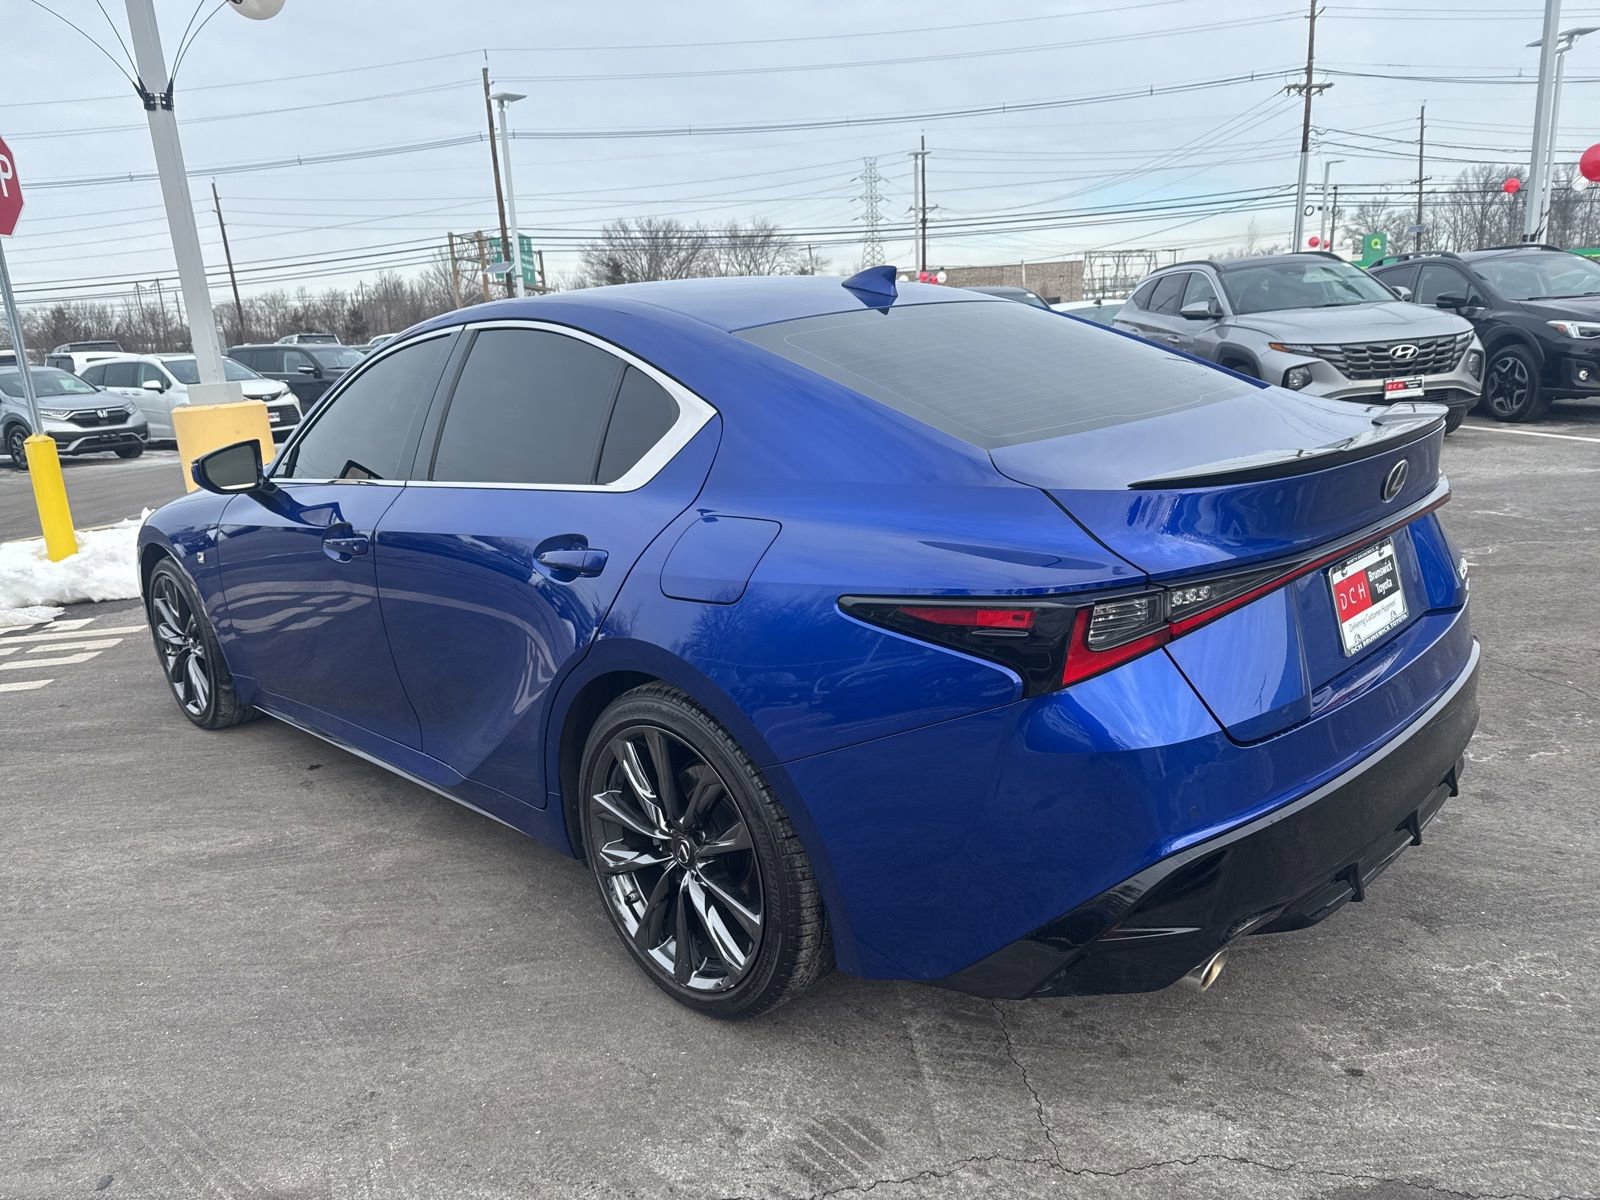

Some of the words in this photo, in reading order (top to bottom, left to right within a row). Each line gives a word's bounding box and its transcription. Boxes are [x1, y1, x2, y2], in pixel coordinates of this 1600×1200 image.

[1368, 560, 1393, 582] Brunswick
[1340, 582, 1366, 610] DCH
[1375, 578, 1393, 595] Toyota
[1351, 641, 1363, 654] DCH
[1390, 613, 1408, 630] TOYOTA
